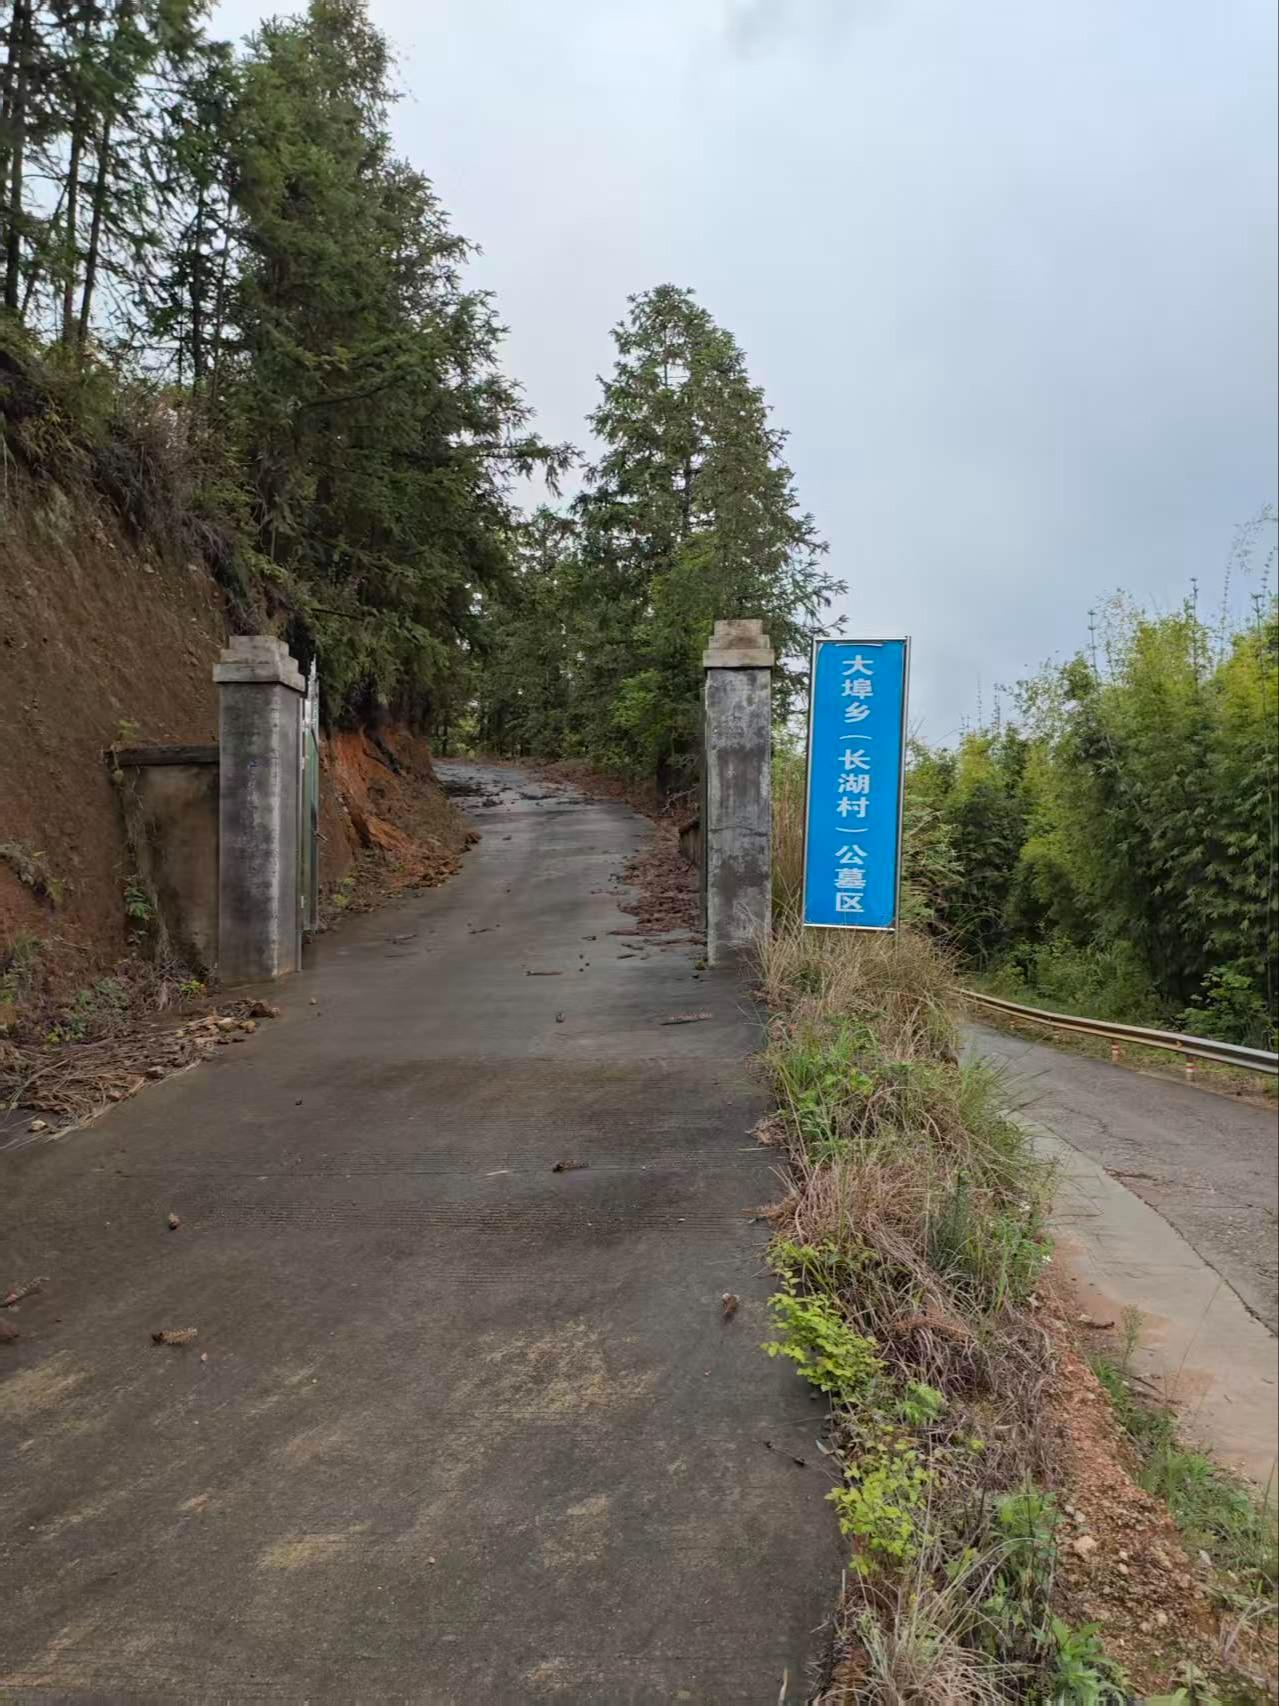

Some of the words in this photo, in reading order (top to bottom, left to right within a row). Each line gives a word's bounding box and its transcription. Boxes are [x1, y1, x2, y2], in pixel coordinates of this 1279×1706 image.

[835, 655, 873, 912] 大埠乡（长湖村）公墓区
